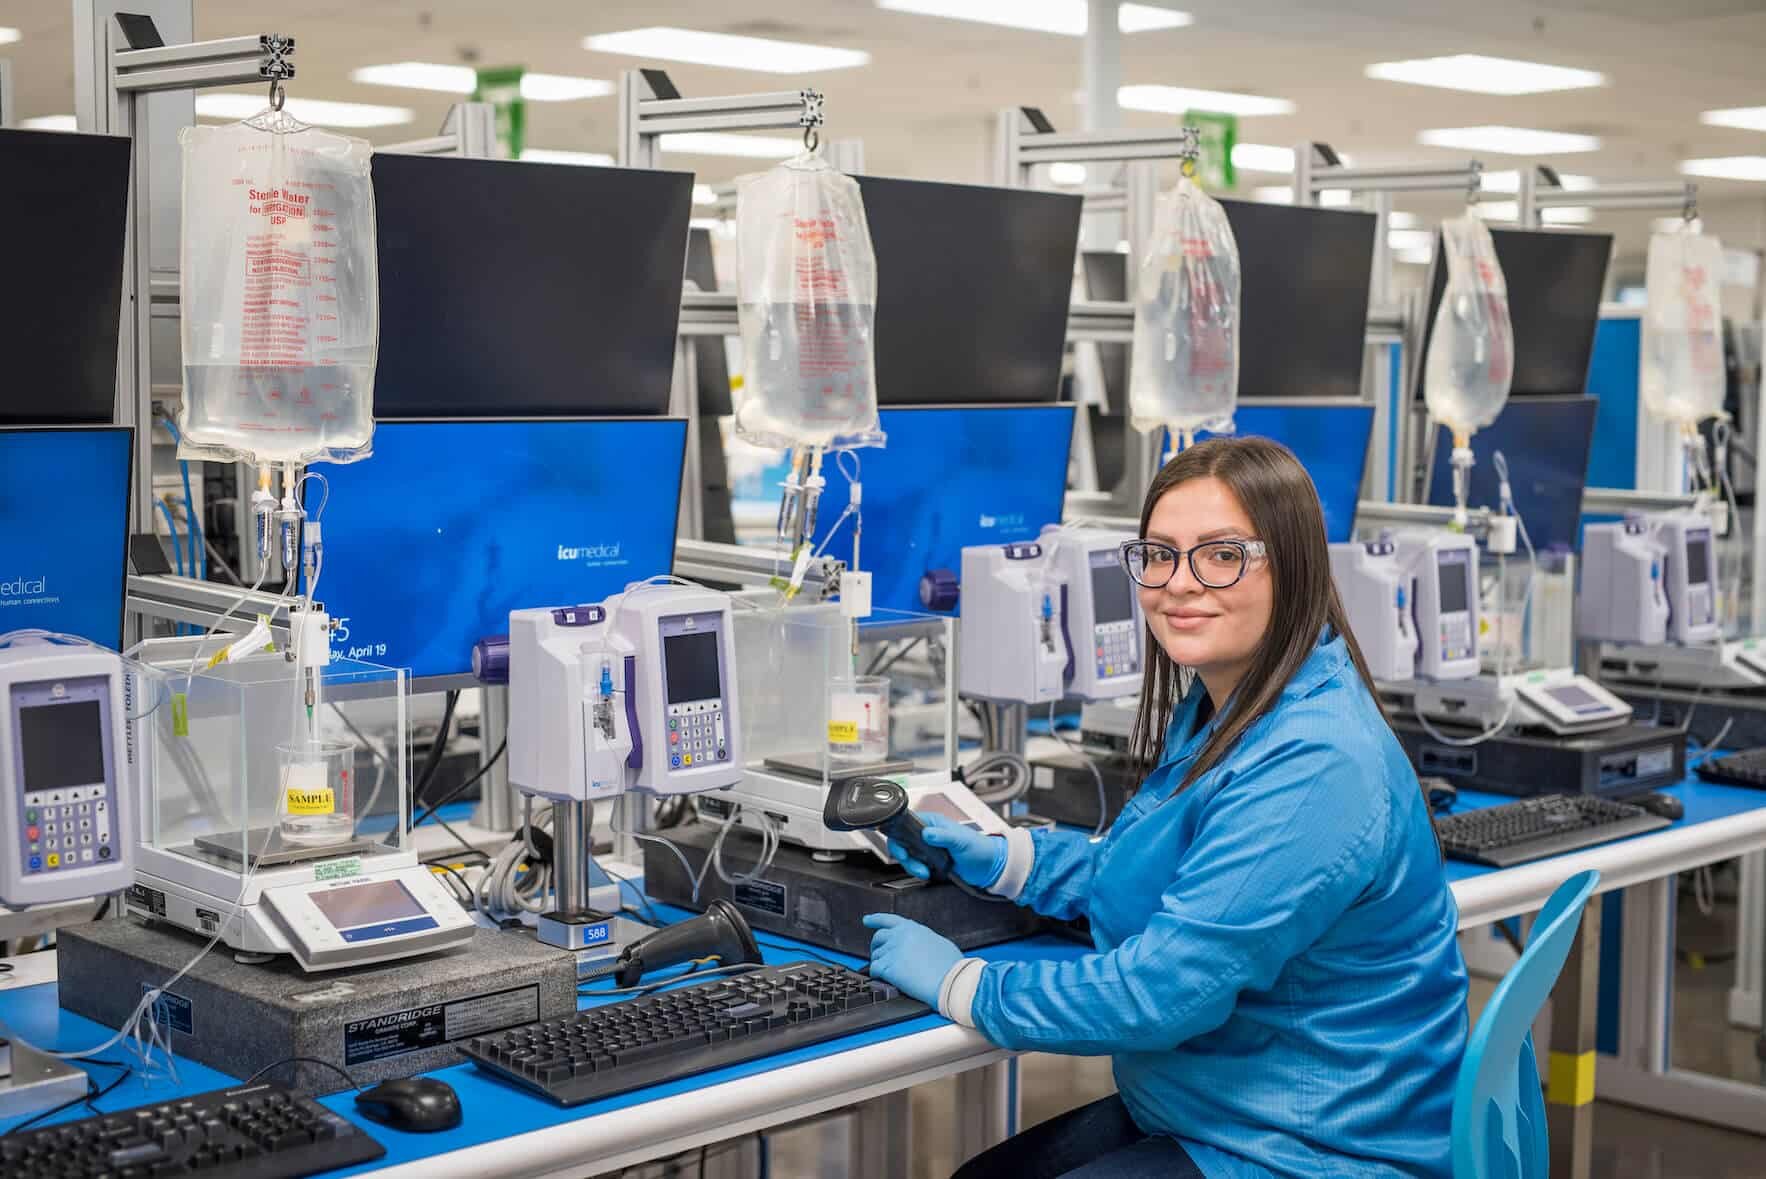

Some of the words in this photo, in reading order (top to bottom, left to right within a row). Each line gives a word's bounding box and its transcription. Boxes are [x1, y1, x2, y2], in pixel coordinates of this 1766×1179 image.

[281, 187, 309, 204] Water
[250, 204, 261, 214] for
[270, 216, 287, 225] USP
[348, 644, 372, 661] April
[375, 643, 387, 657] 19
[288, 793, 333, 804] SAMPLE
[348, 1004, 442, 1033] STANDRIDGE
